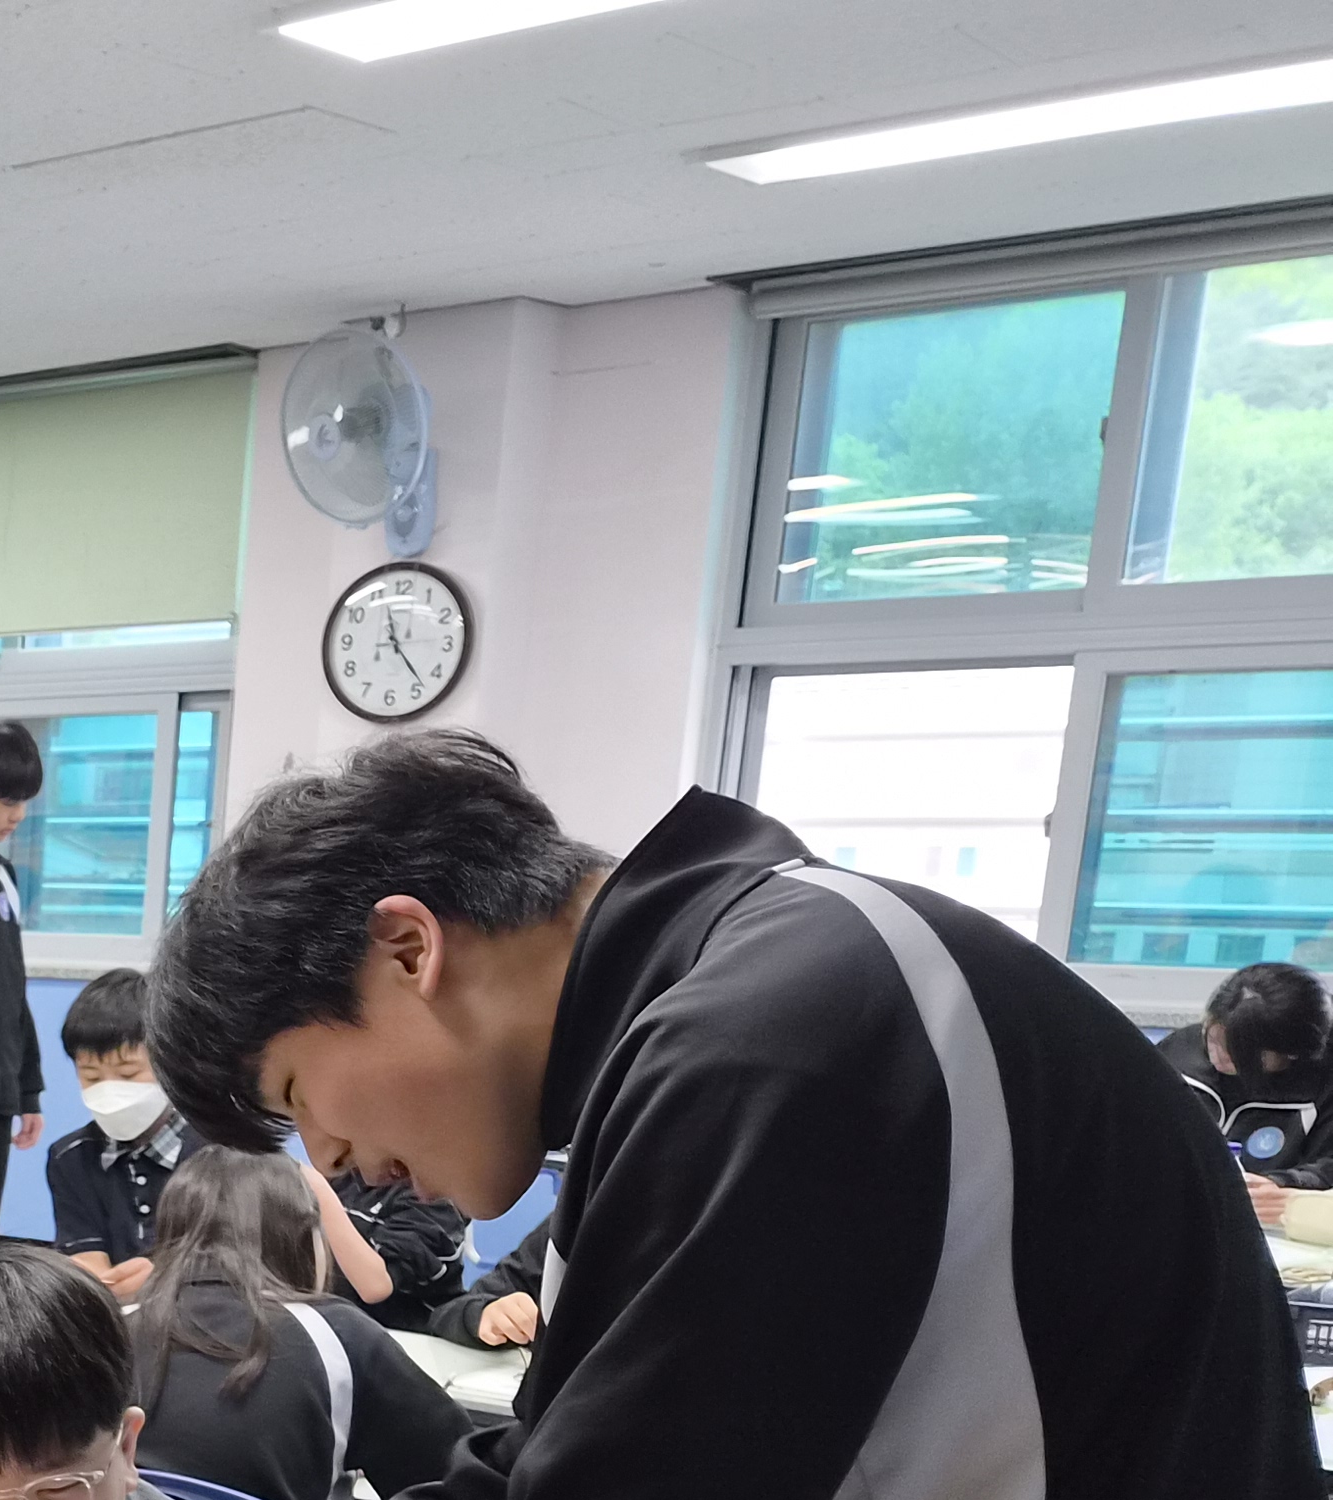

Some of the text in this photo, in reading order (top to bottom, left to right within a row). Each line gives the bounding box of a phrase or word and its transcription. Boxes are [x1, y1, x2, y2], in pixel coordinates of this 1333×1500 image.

[395, 580, 413, 595] 12
[426, 588, 433, 604] 1
[348, 607, 365, 624] 10
[438, 607, 452, 625] 2
[341, 633, 353, 651] 9
[442, 635, 453, 652] 3
[344, 660, 357, 677] 8
[430, 663, 442, 679] 4
[361, 682, 372, 698] 7
[384, 690, 396, 706] 6
[410, 683, 422, 700] 5
